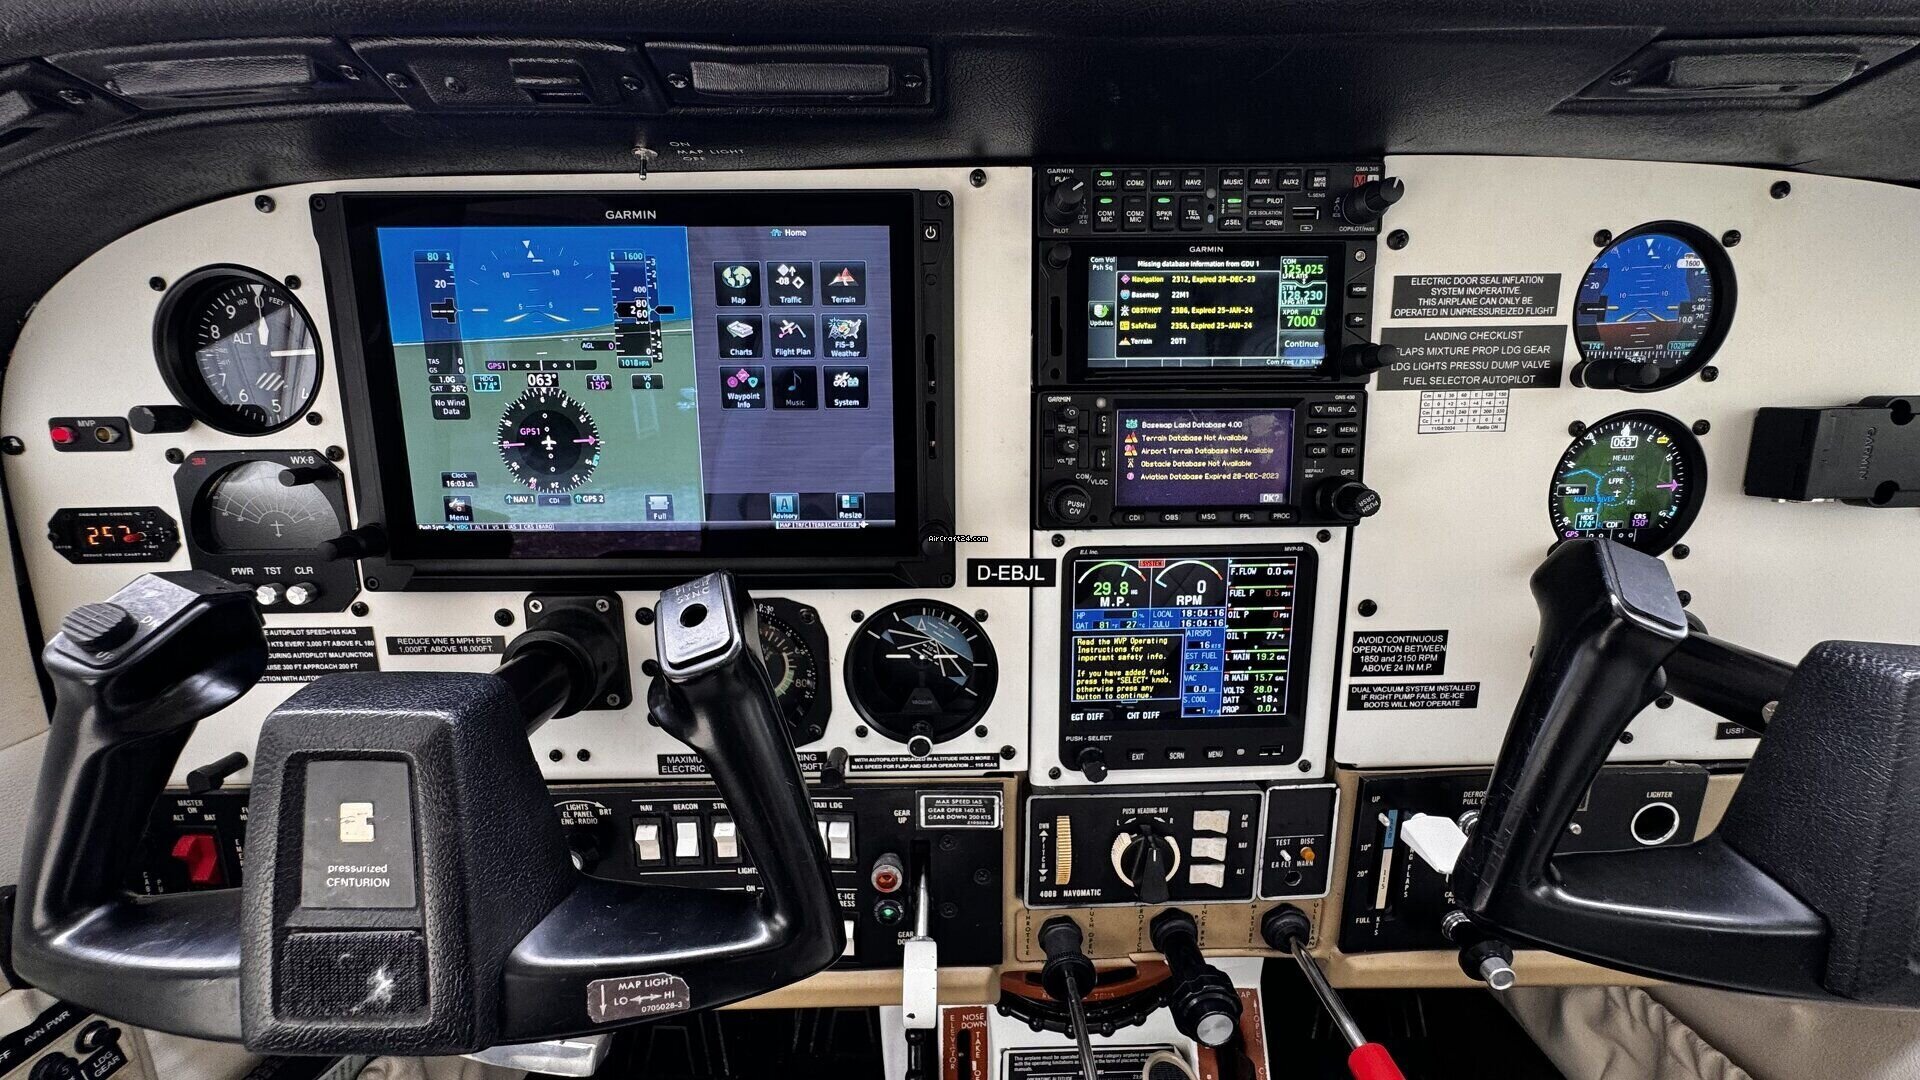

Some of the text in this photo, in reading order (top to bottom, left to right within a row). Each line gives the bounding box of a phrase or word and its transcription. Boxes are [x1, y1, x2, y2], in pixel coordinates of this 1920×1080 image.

[605, 210, 656, 220] GARMIN
[785, 228, 806, 236] Home
[623, 252, 643, 260] 1600
[1283, 264, 1324, 274] 125.025
[434, 280, 446, 289] 20
[1411, 276, 1544, 286] ELECTRIC DOOR SEAL INFLATION
[1283, 290, 1323, 300] 128.230
[1430, 286, 1522, 296] SYSTEM INOPERATIVE.
[268, 296, 284, 306] FEET
[731, 295, 746, 304] Map
[780, 295, 802, 304] Traffic
[831, 295, 856, 303] Terrain
[1418, 296, 1533, 306] THIS AIRPLANE CAN ONLY BE
[226, 304, 236, 319] 9
[1394, 306, 1554, 317] OPERATED IN UNPRESSUREIZED FLIGHT
[1286, 316, 1316, 327] 7000
[210, 324, 220, 339] 8
[1424, 331, 1524, 341] LANDING CHECKLIST
[232, 332, 252, 345] ALT
[730, 348, 752, 356] Charts
[775, 348, 794, 356] Flight
[1426, 346, 1468, 355] MIXTURE
[1472, 346, 1500, 354] PROP
[1501, 346, 1522, 354] LDG
[1522, 345, 1551, 354] GEAR
[1390, 360, 1550, 371] LDG LIGHTS PRESSU DUMP VALVE
[528, 374, 556, 386] 063°
[1403, 375, 1536, 386] FUEL SELECTOR AUTOPILOT
[727, 392, 760, 401] Waypoint
[786, 398, 805, 406] Music
[834, 398, 859, 407] System
[442, 408, 460, 416] Data
[77, 420, 96, 428] MVP
[520, 428, 541, 436] GPS1
[512, 496, 529, 504] NAV
[231, 567, 255, 576] PWR
[264, 566, 282, 575] TST
[294, 566, 314, 575] CLR
[978, 564, 1046, 581] D-EBJL
[1093, 582, 1129, 596] 29.8
[677, 587, 710, 604] SYNC
[1100, 596, 1130, 607] M.P.
[1176, 596, 1202, 606] RPM
[1182, 609, 1224, 618] 18:04:16
[1182, 620, 1224, 628] 16:04:16
[397, 638, 430, 646] REDUCE
[1386, 635, 1444, 644] CONTINUOUS
[430, 646, 458, 654] ABOVE
[1436, 684, 1476, 692] INSTALLED
[673, 802, 698, 810] BEACON
[598, 808, 612, 816] BRT
[898, 816, 908, 824] UP
[327, 864, 388, 874] pressurized
[1064, 888, 1101, 898] NAVOMATIC
[618, 978, 674, 991] MAP LIGHT
[664, 990, 675, 999] HI
[614, 997, 628, 1006] LO
[641, 1002, 683, 1013] 0705028-3
[962, 1014, 984, 1022] NOSE
[24, 1010, 71, 1046] AVN PWR
[961, 1021, 986, 1029] DOWN
